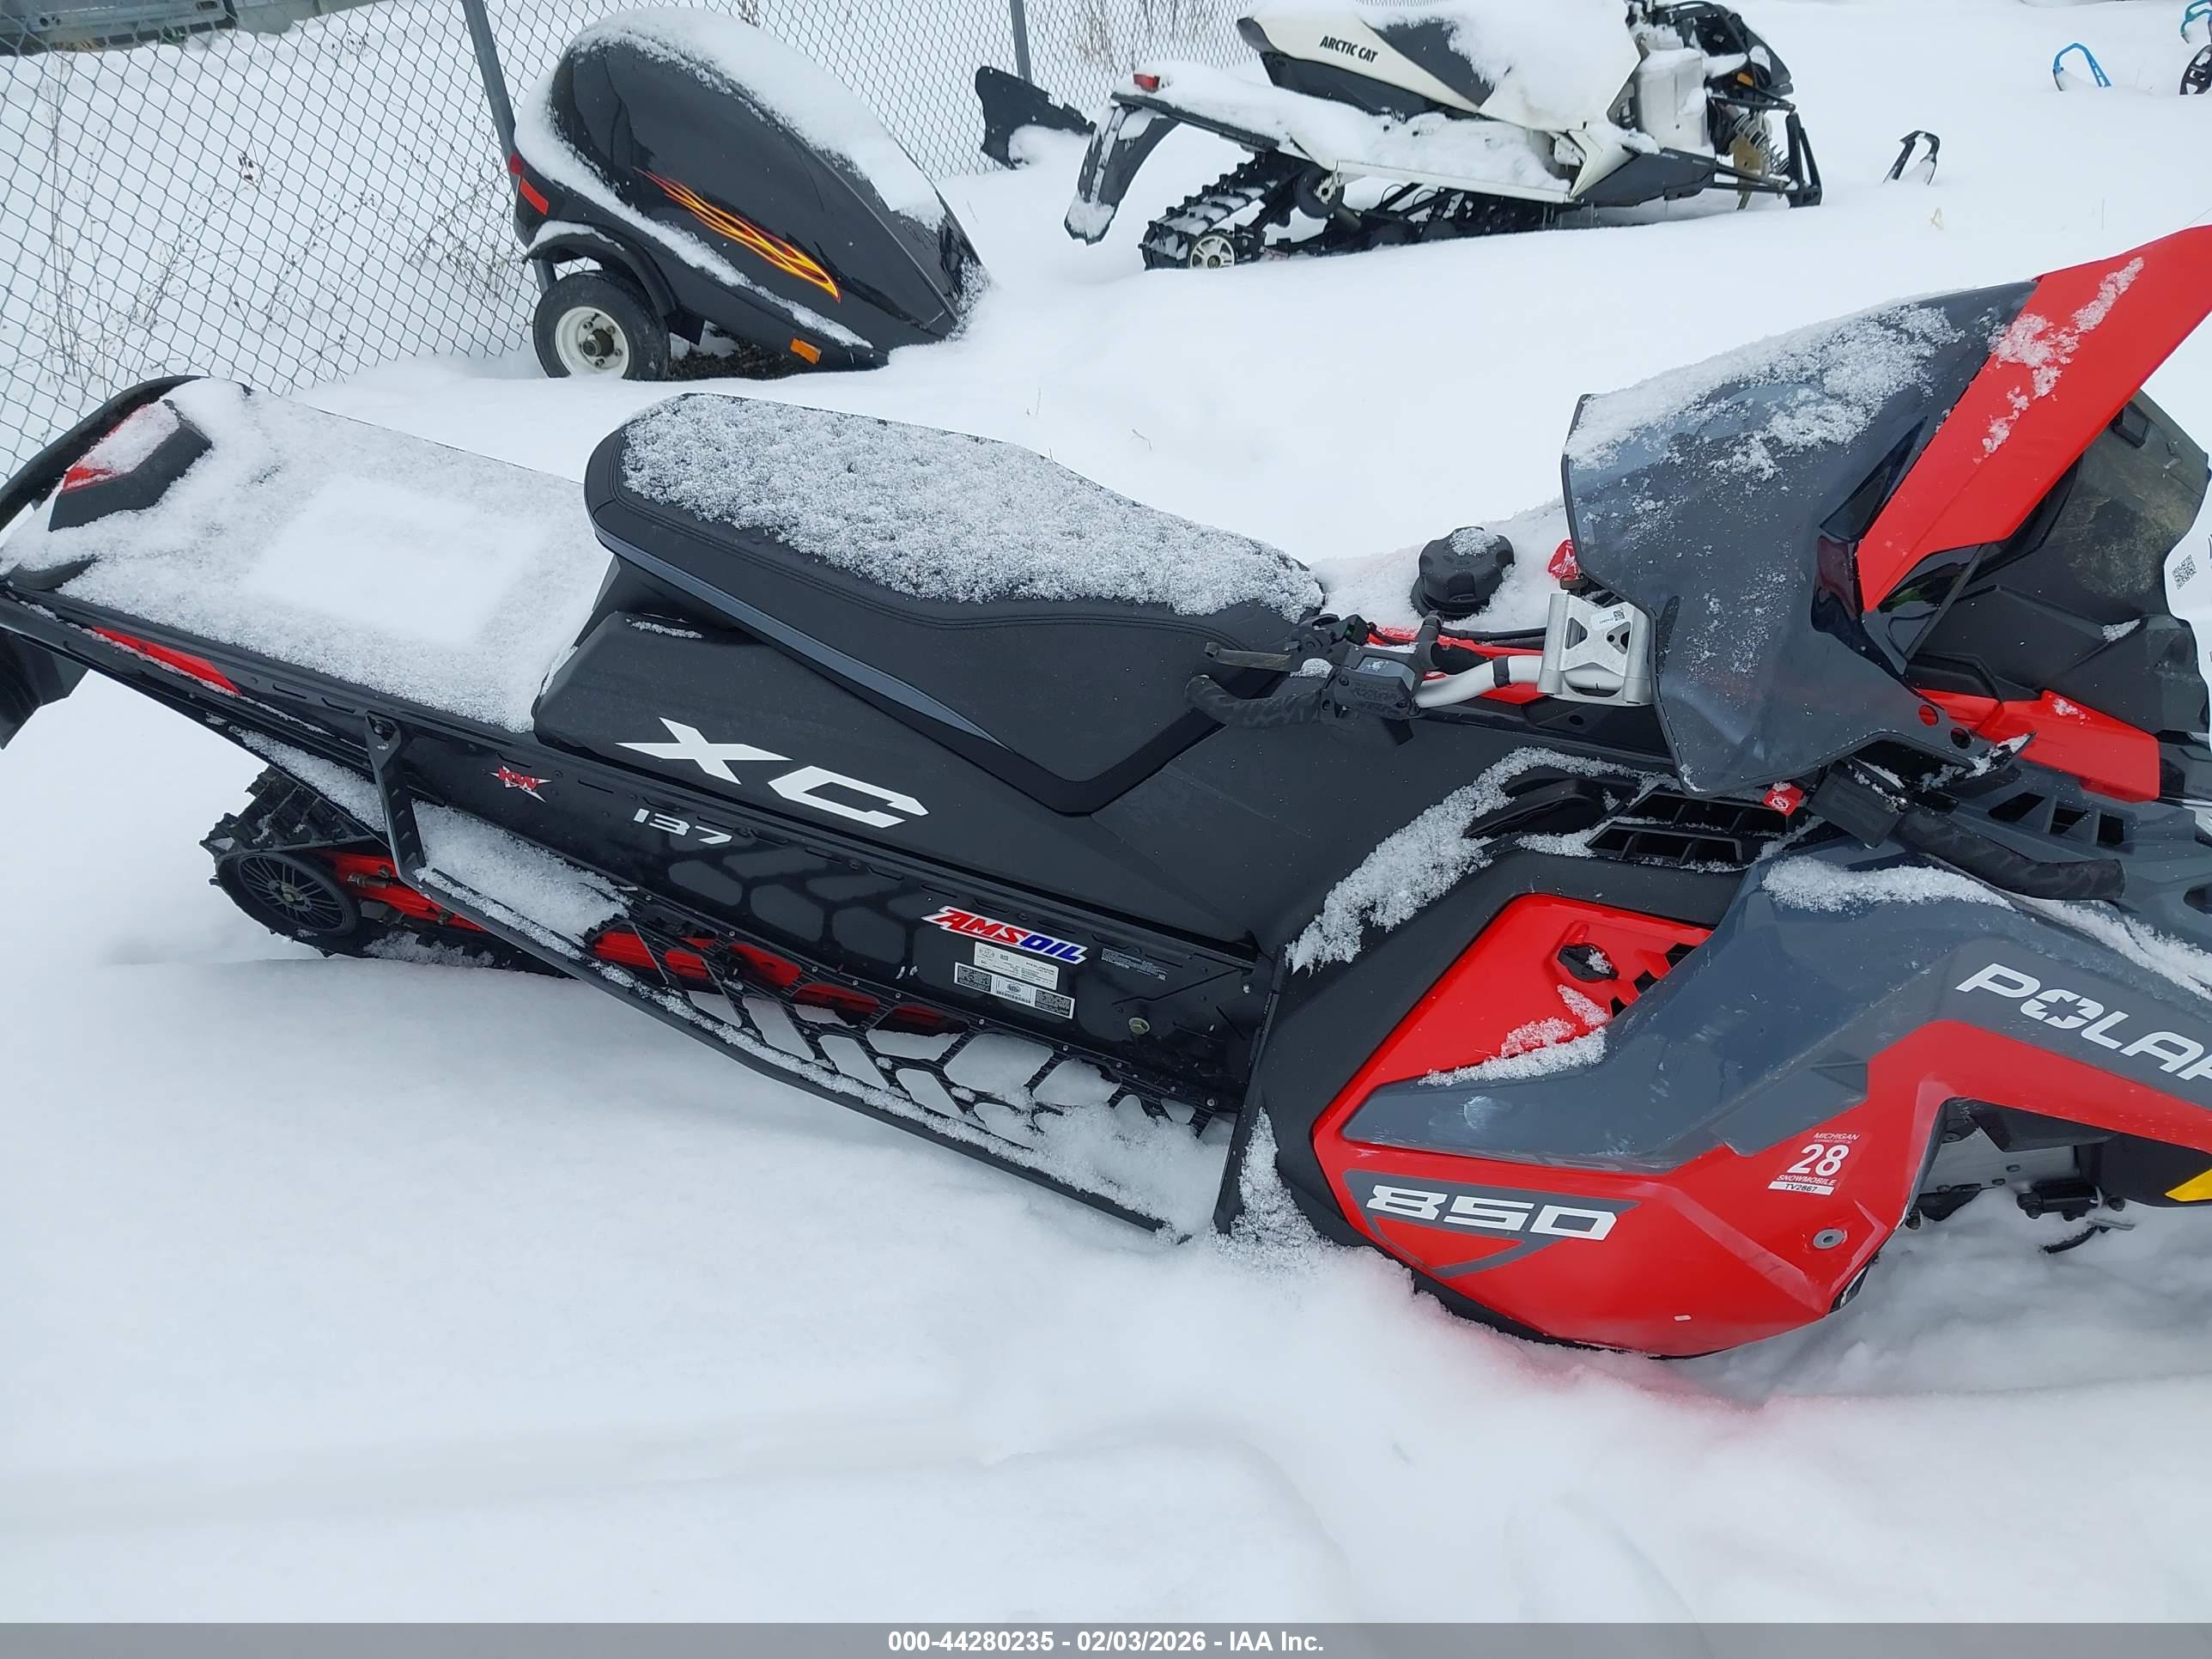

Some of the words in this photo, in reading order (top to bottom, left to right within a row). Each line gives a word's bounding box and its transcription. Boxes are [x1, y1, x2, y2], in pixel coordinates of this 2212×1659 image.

[1320, 35, 1358, 56] ARCTIC
[1358, 47, 1378, 63] CAT
[616, 717, 929, 829] XC
[634, 809, 732, 845] 137
[933, 908, 1080, 963] AMSOIL
[1787, 1144, 1850, 1176] 28
[1777, 1175, 1838, 1186] SNOWMOBILE
[1785, 1183, 1818, 1192] TV2867
[1366, 1185, 1617, 1241] 850
